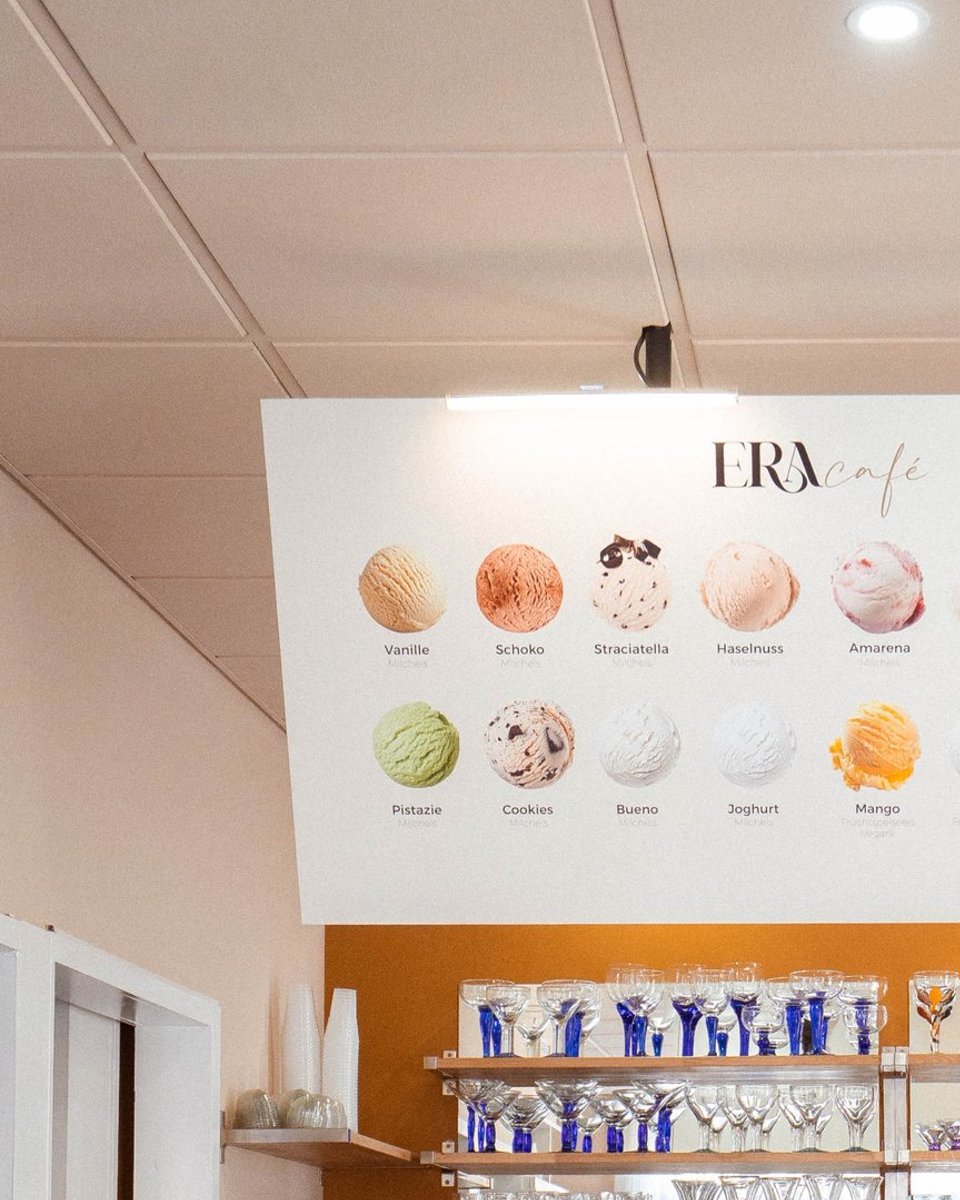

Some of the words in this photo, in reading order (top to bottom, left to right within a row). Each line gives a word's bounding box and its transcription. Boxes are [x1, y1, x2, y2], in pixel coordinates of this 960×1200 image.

[711, 441, 823, 494] ERA
[824, 442, 928, 518] café
[383, 643, 430, 656] Vanille
[495, 643, 545, 656] Schoko
[593, 642, 669, 655] Straciatella
[716, 642, 784, 655] Haselnuss
[848, 642, 911, 654] Amarena
[391, 803, 443, 816] Pistazie
[502, 803, 554, 816] Cookies
[616, 803, 659, 815] Bueno
[727, 803, 780, 817] Joghurt
[855, 803, 901, 817] Mango
